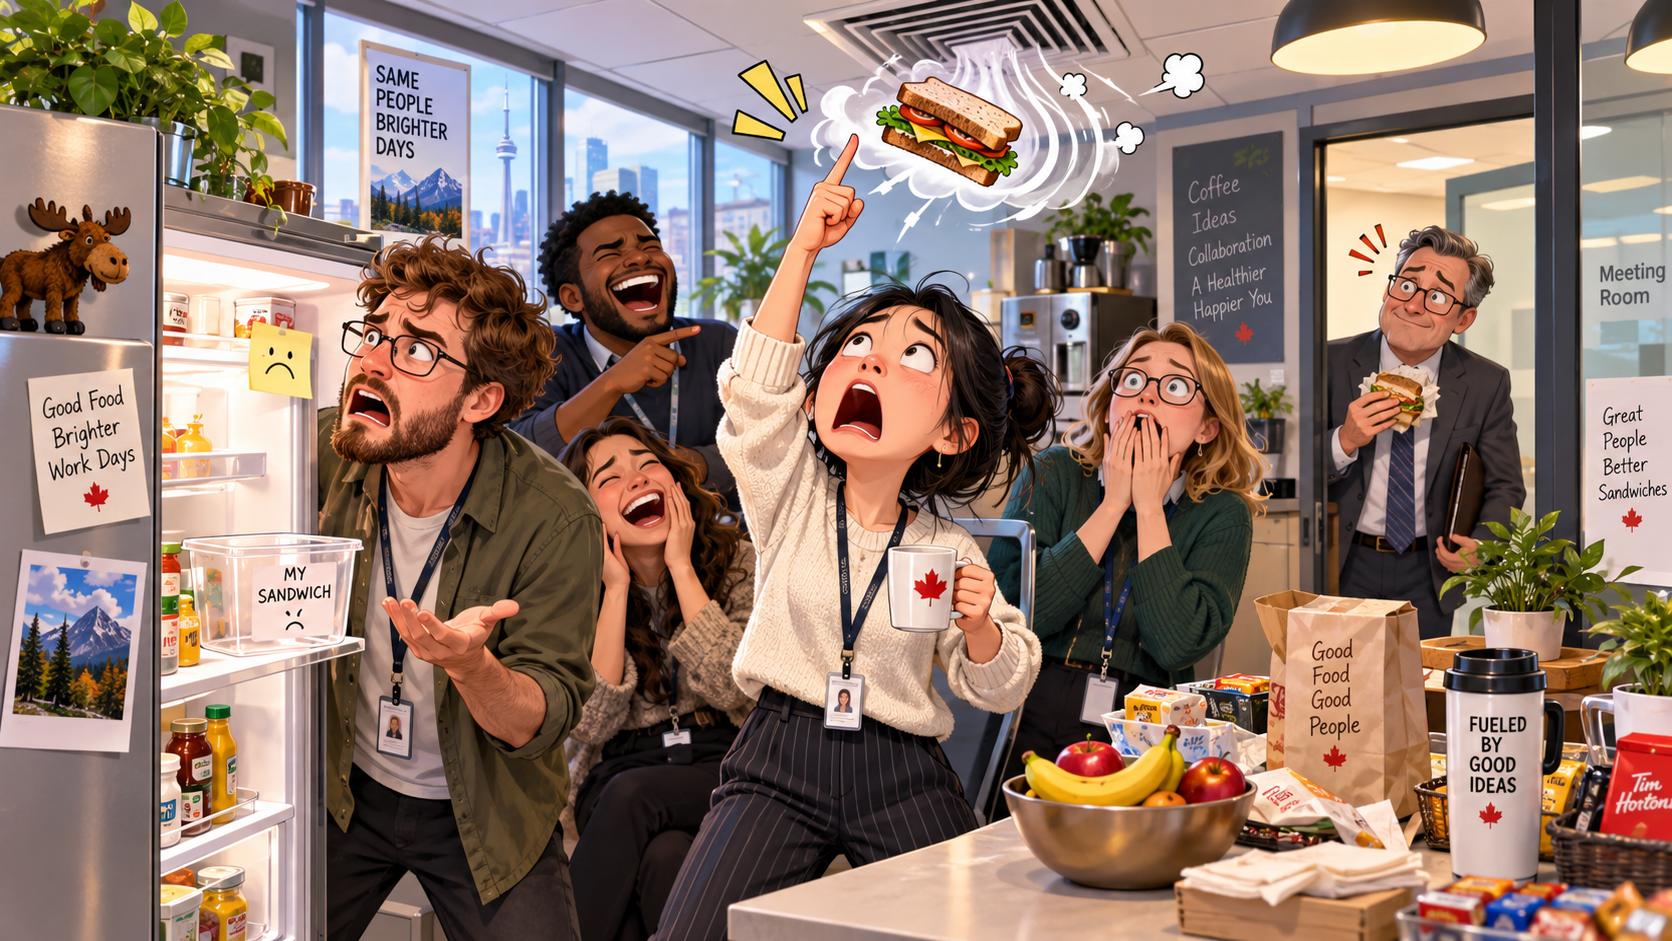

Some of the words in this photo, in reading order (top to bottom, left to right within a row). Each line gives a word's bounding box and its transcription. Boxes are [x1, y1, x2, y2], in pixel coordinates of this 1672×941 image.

[376, 64, 419, 90] SAME
[376, 88, 433, 115] PEOPLE
[376, 112, 448, 140] BRIGHTER
[376, 136, 415, 159] DAYS
[1188, 173, 1240, 204] Coffee
[1192, 208, 1237, 235] Ideas
[1188, 233, 1272, 266] Collaboration
[1191, 276, 1202, 297] A
[1207, 265, 1267, 293] Healthier
[1600, 262, 1666, 284] Meeting
[1193, 296, 1244, 322] Happier
[1248, 288, 1273, 308] You
[1600, 288, 1650, 306] Room
[42, 391, 83, 419] Good
[88, 384, 124, 411] Food
[1602, 404, 1644, 427] Great
[51, 419, 120, 450] Brighter
[1602, 429, 1648, 454] People
[48, 452, 93, 481] Work
[96, 448, 136, 472] Days
[1602, 456, 1648, 477] Better
[1598, 480, 1668, 502] Sandwiches
[283, 566, 307, 581] MY
[258, 584, 332, 604] SANDWICH
[1312, 638, 1354, 661] Good
[1312, 663, 1351, 685] Food
[1312, 687, 1352, 710] Good
[1310, 713, 1361, 741] People
[1470, 715, 1527, 733] FUELED
[1481, 736, 1503, 753] BY
[1470, 756, 1517, 774] GOOD
[1470, 776, 1517, 794] IDEAS
[1631, 772, 1663, 793] Tim
